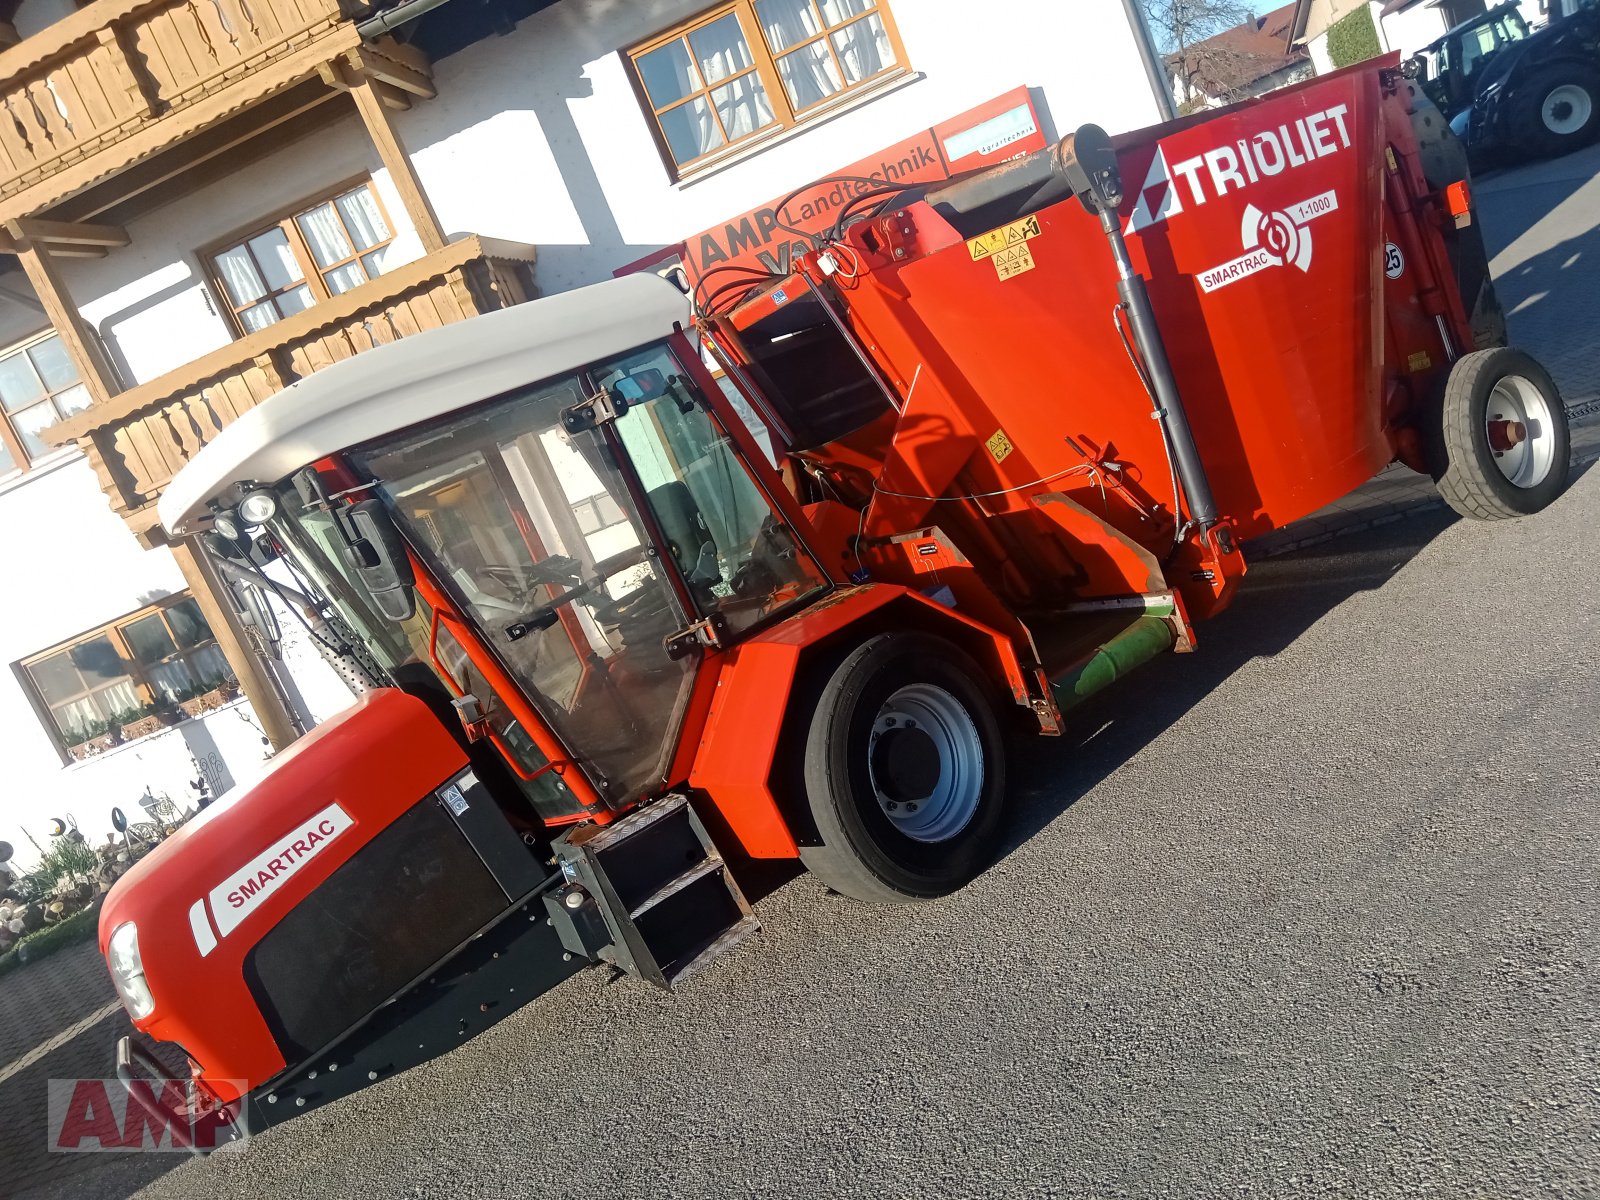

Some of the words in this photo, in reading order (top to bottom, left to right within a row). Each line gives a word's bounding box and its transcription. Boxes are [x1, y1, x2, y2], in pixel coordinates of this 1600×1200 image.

[981, 126, 1034, 153] Agrartechnik
[1172, 103, 1351, 206] TRIOLIET
[699, 208, 777, 271] AMP
[783, 146, 936, 227] Landtechnik
[1298, 197, 1331, 219] 1-1000
[1204, 252, 1268, 288] SMARTRAC
[227, 819, 335, 909] SMARTRAC
